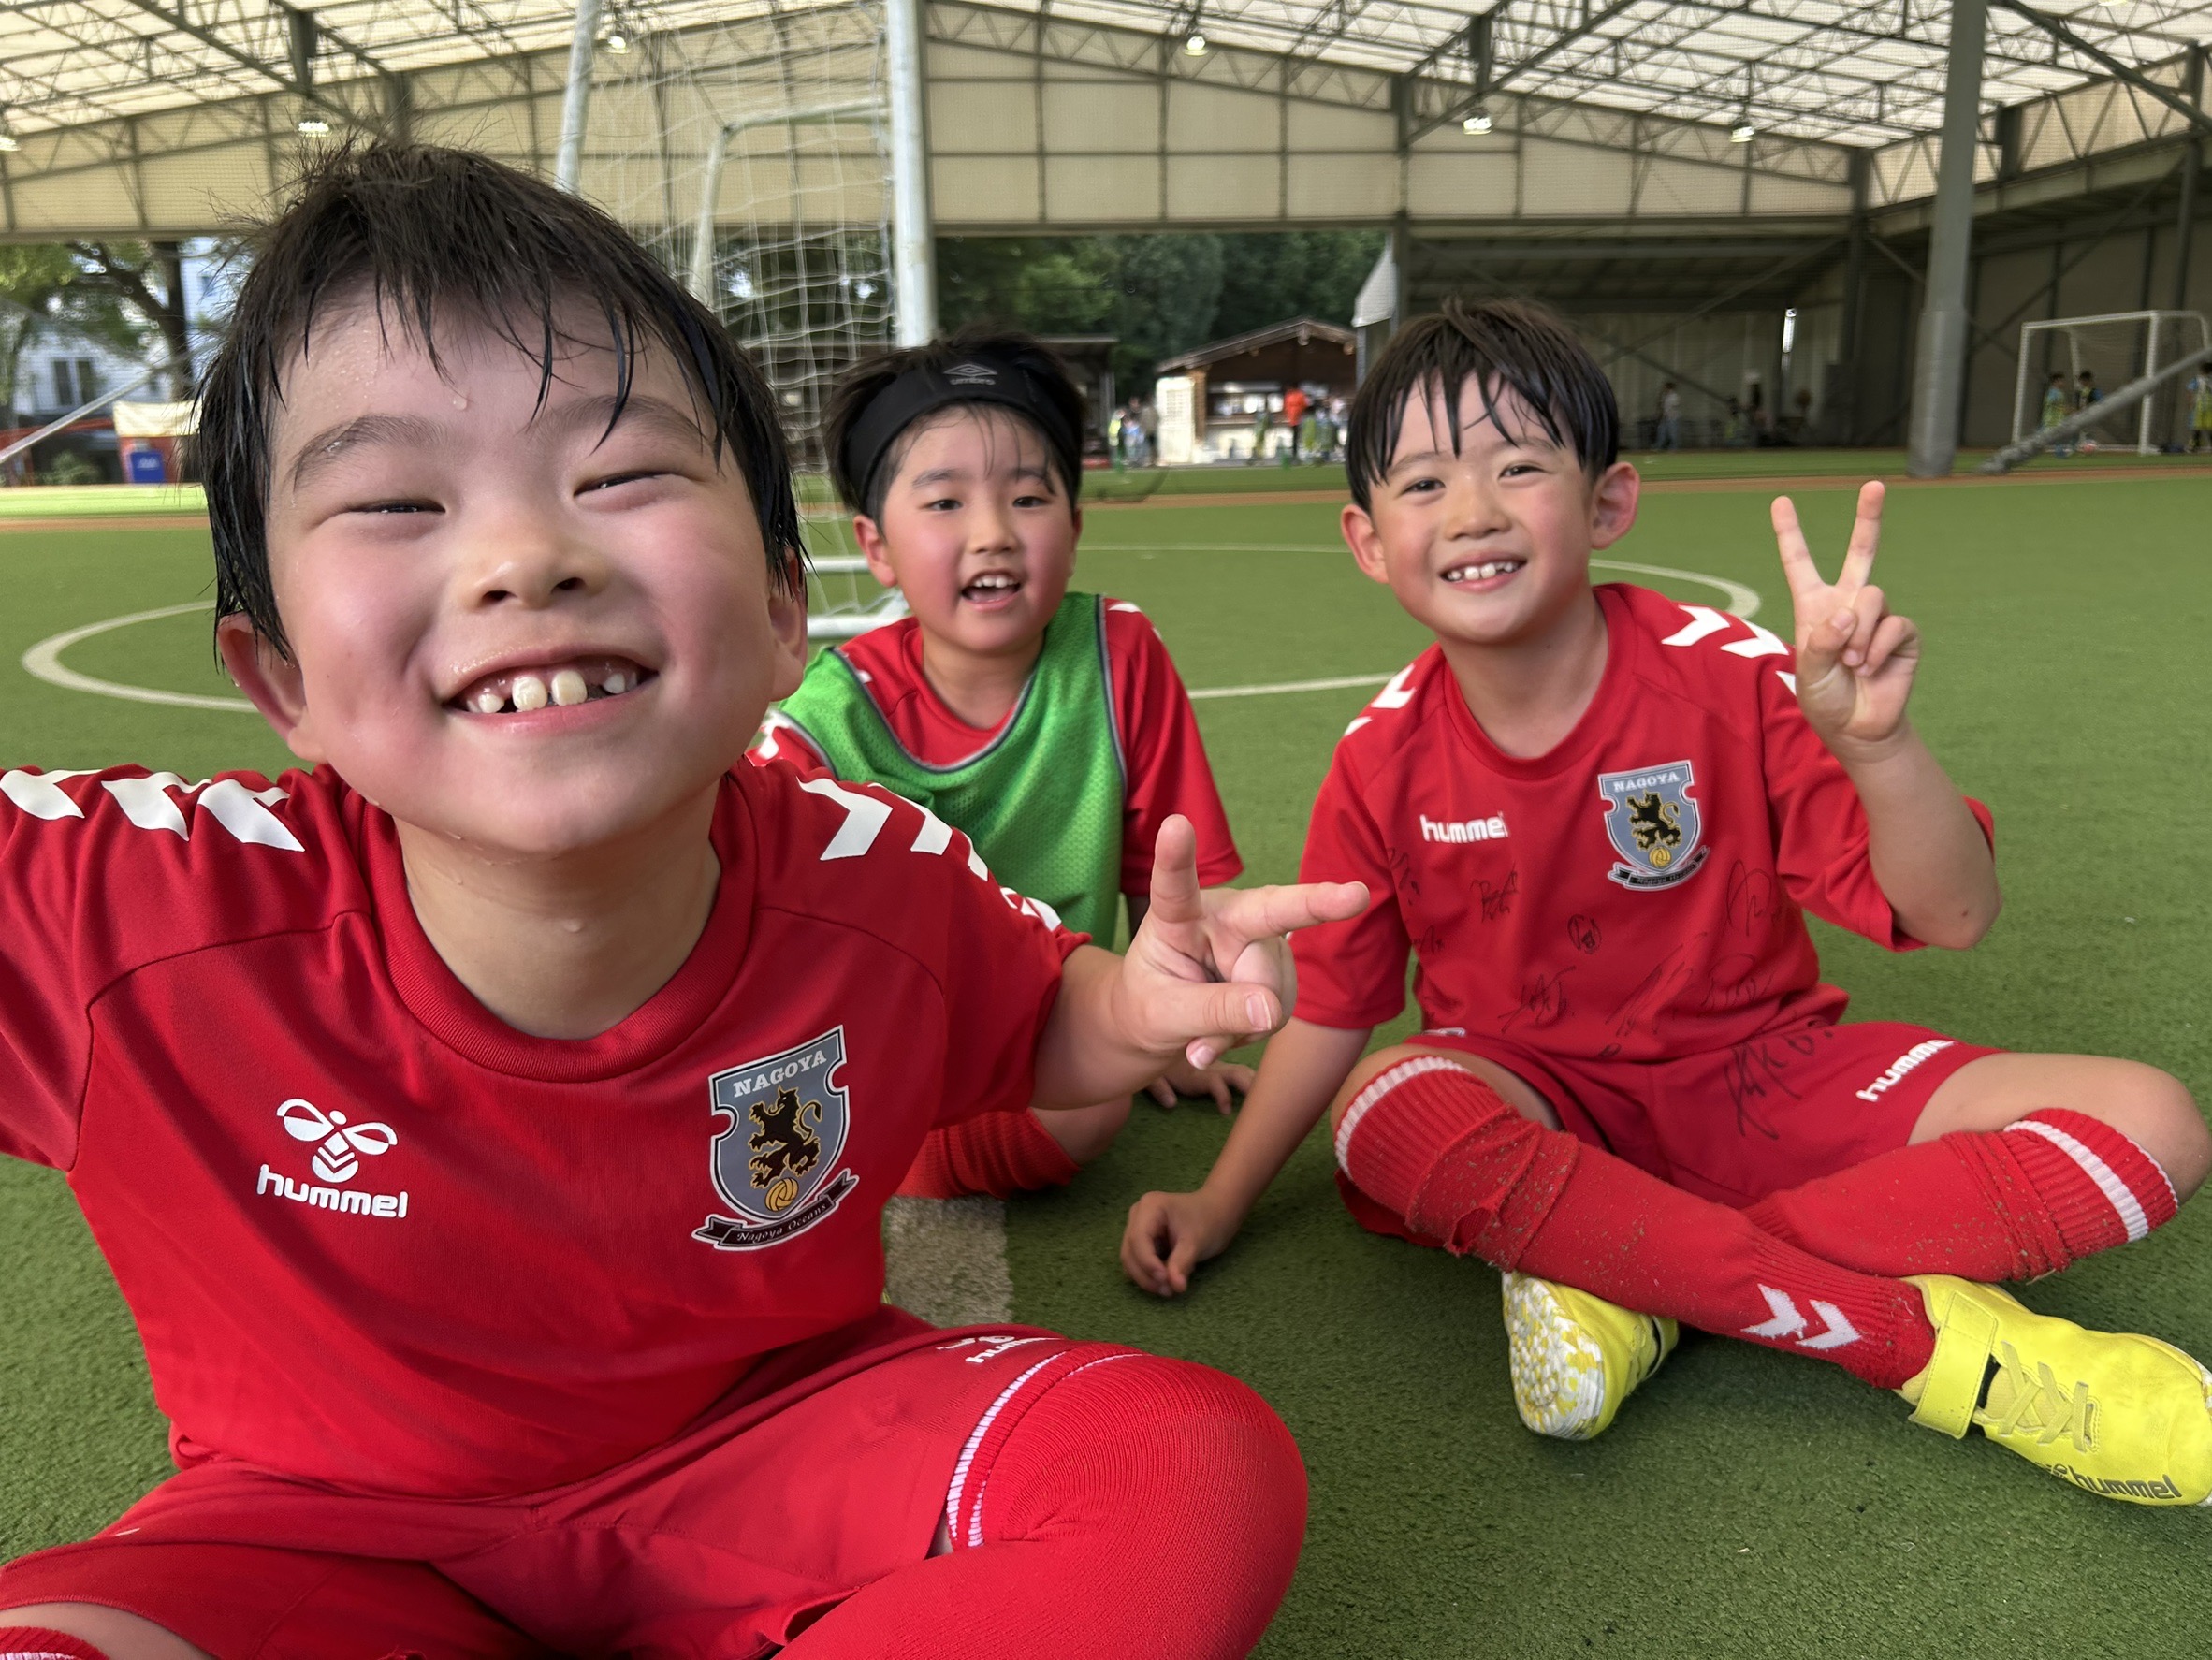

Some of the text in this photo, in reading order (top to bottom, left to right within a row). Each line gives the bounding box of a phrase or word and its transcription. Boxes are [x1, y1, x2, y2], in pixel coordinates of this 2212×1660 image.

[1613, 771, 1681, 793] NAGOYA
[733, 1049, 827, 1099] NAGOYA
[1855, 1039, 1957, 1102] humme
[256, 1163, 409, 1218] hummel
[736, 1203, 826, 1244] Nagoya Oceans
[2067, 1464, 2183, 1499] hummel
